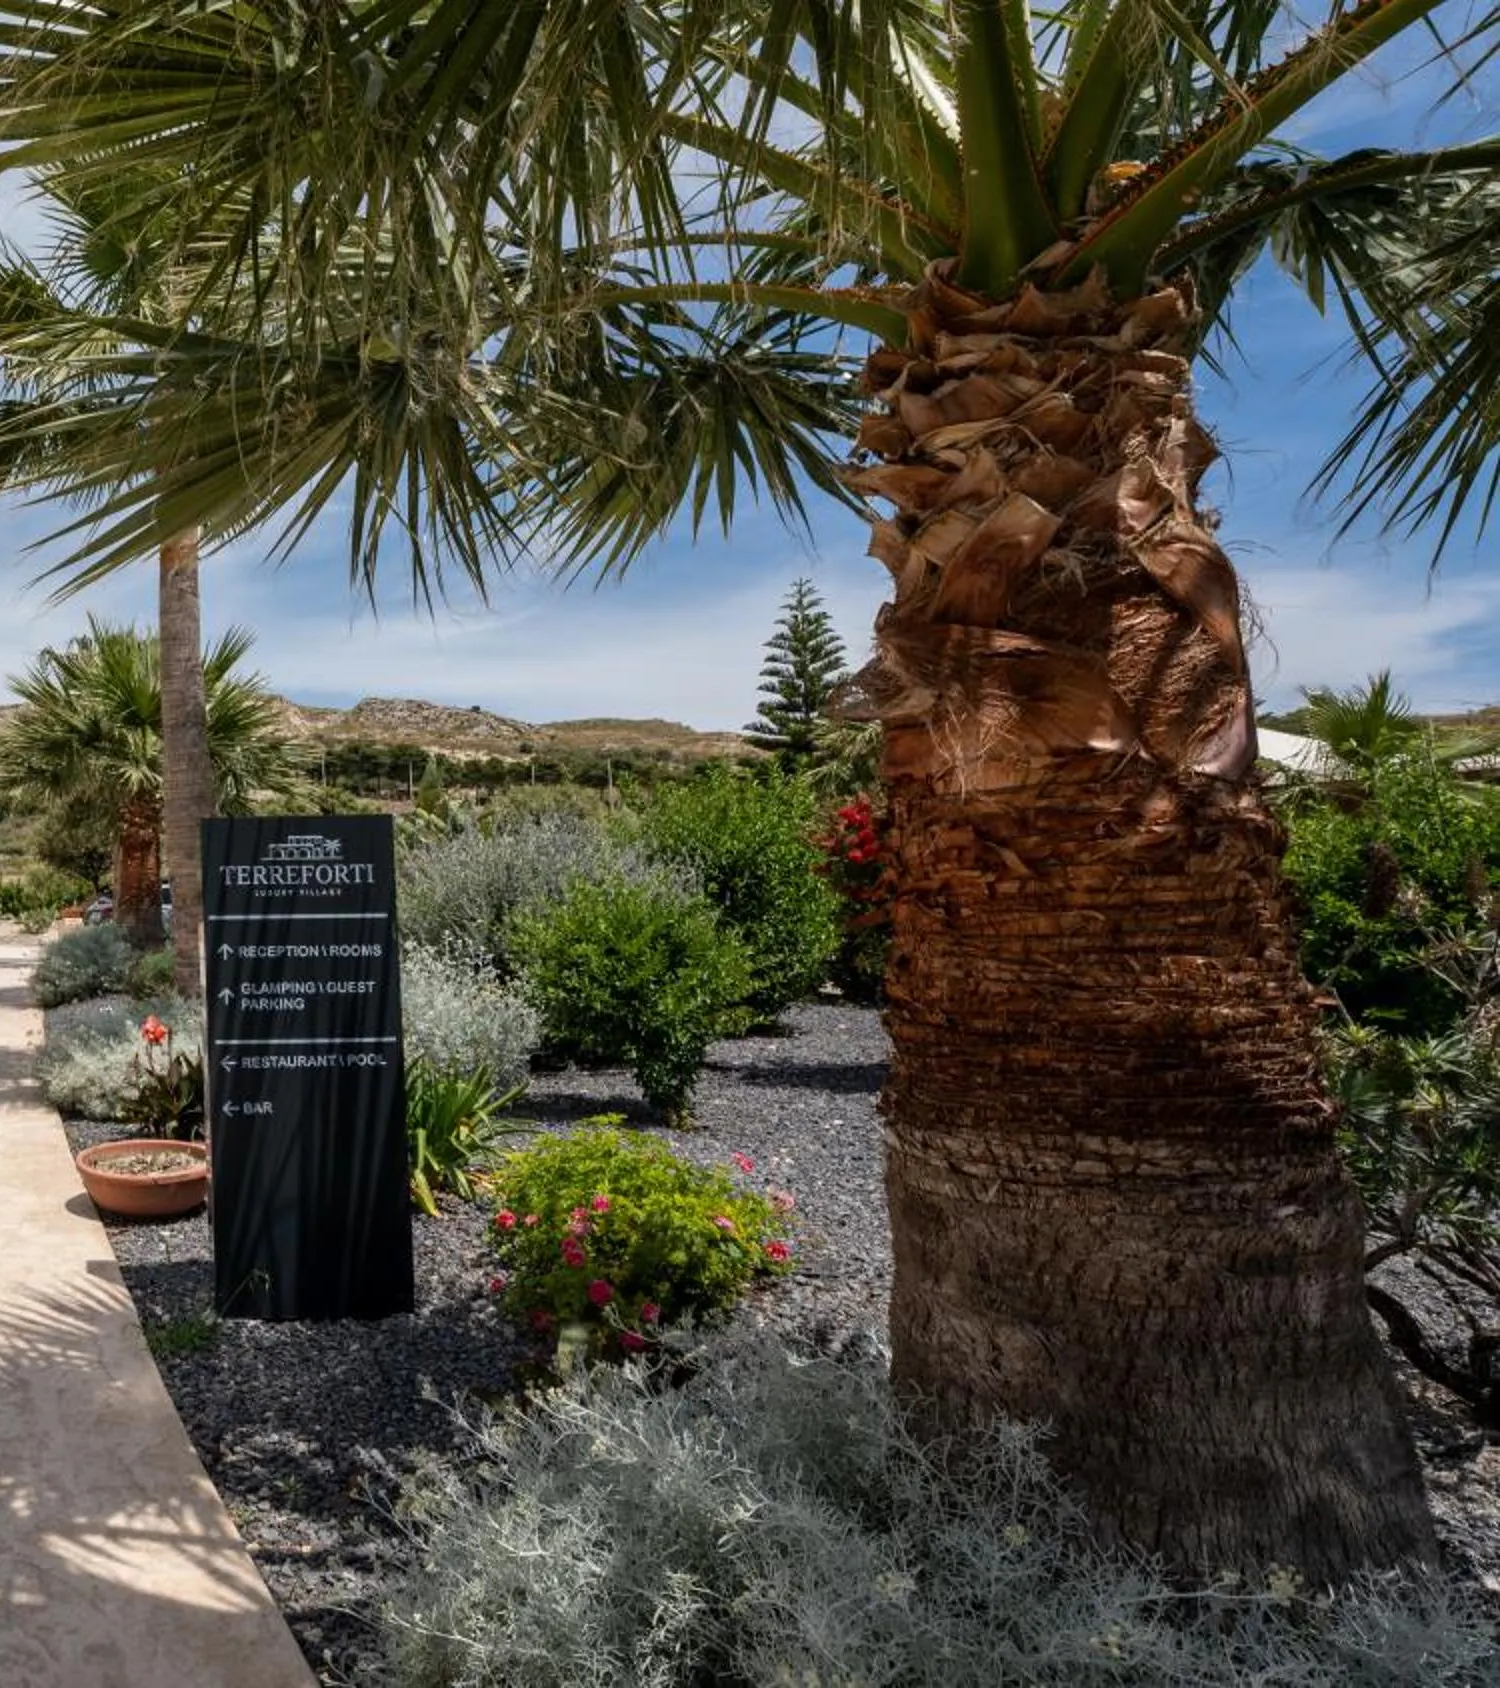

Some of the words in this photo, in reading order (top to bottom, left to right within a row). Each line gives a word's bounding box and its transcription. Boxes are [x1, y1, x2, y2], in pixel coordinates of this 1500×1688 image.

[220, 863, 375, 886] TERREFORTI
[238, 945, 319, 958] RECEPTION
[329, 944, 383, 957] ROOMS
[240, 998, 305, 1011] PARKING
[240, 1056, 336, 1069] RESTAURANT
[347, 1053, 388, 1066] POOL
[243, 1102, 273, 1114] BAR
